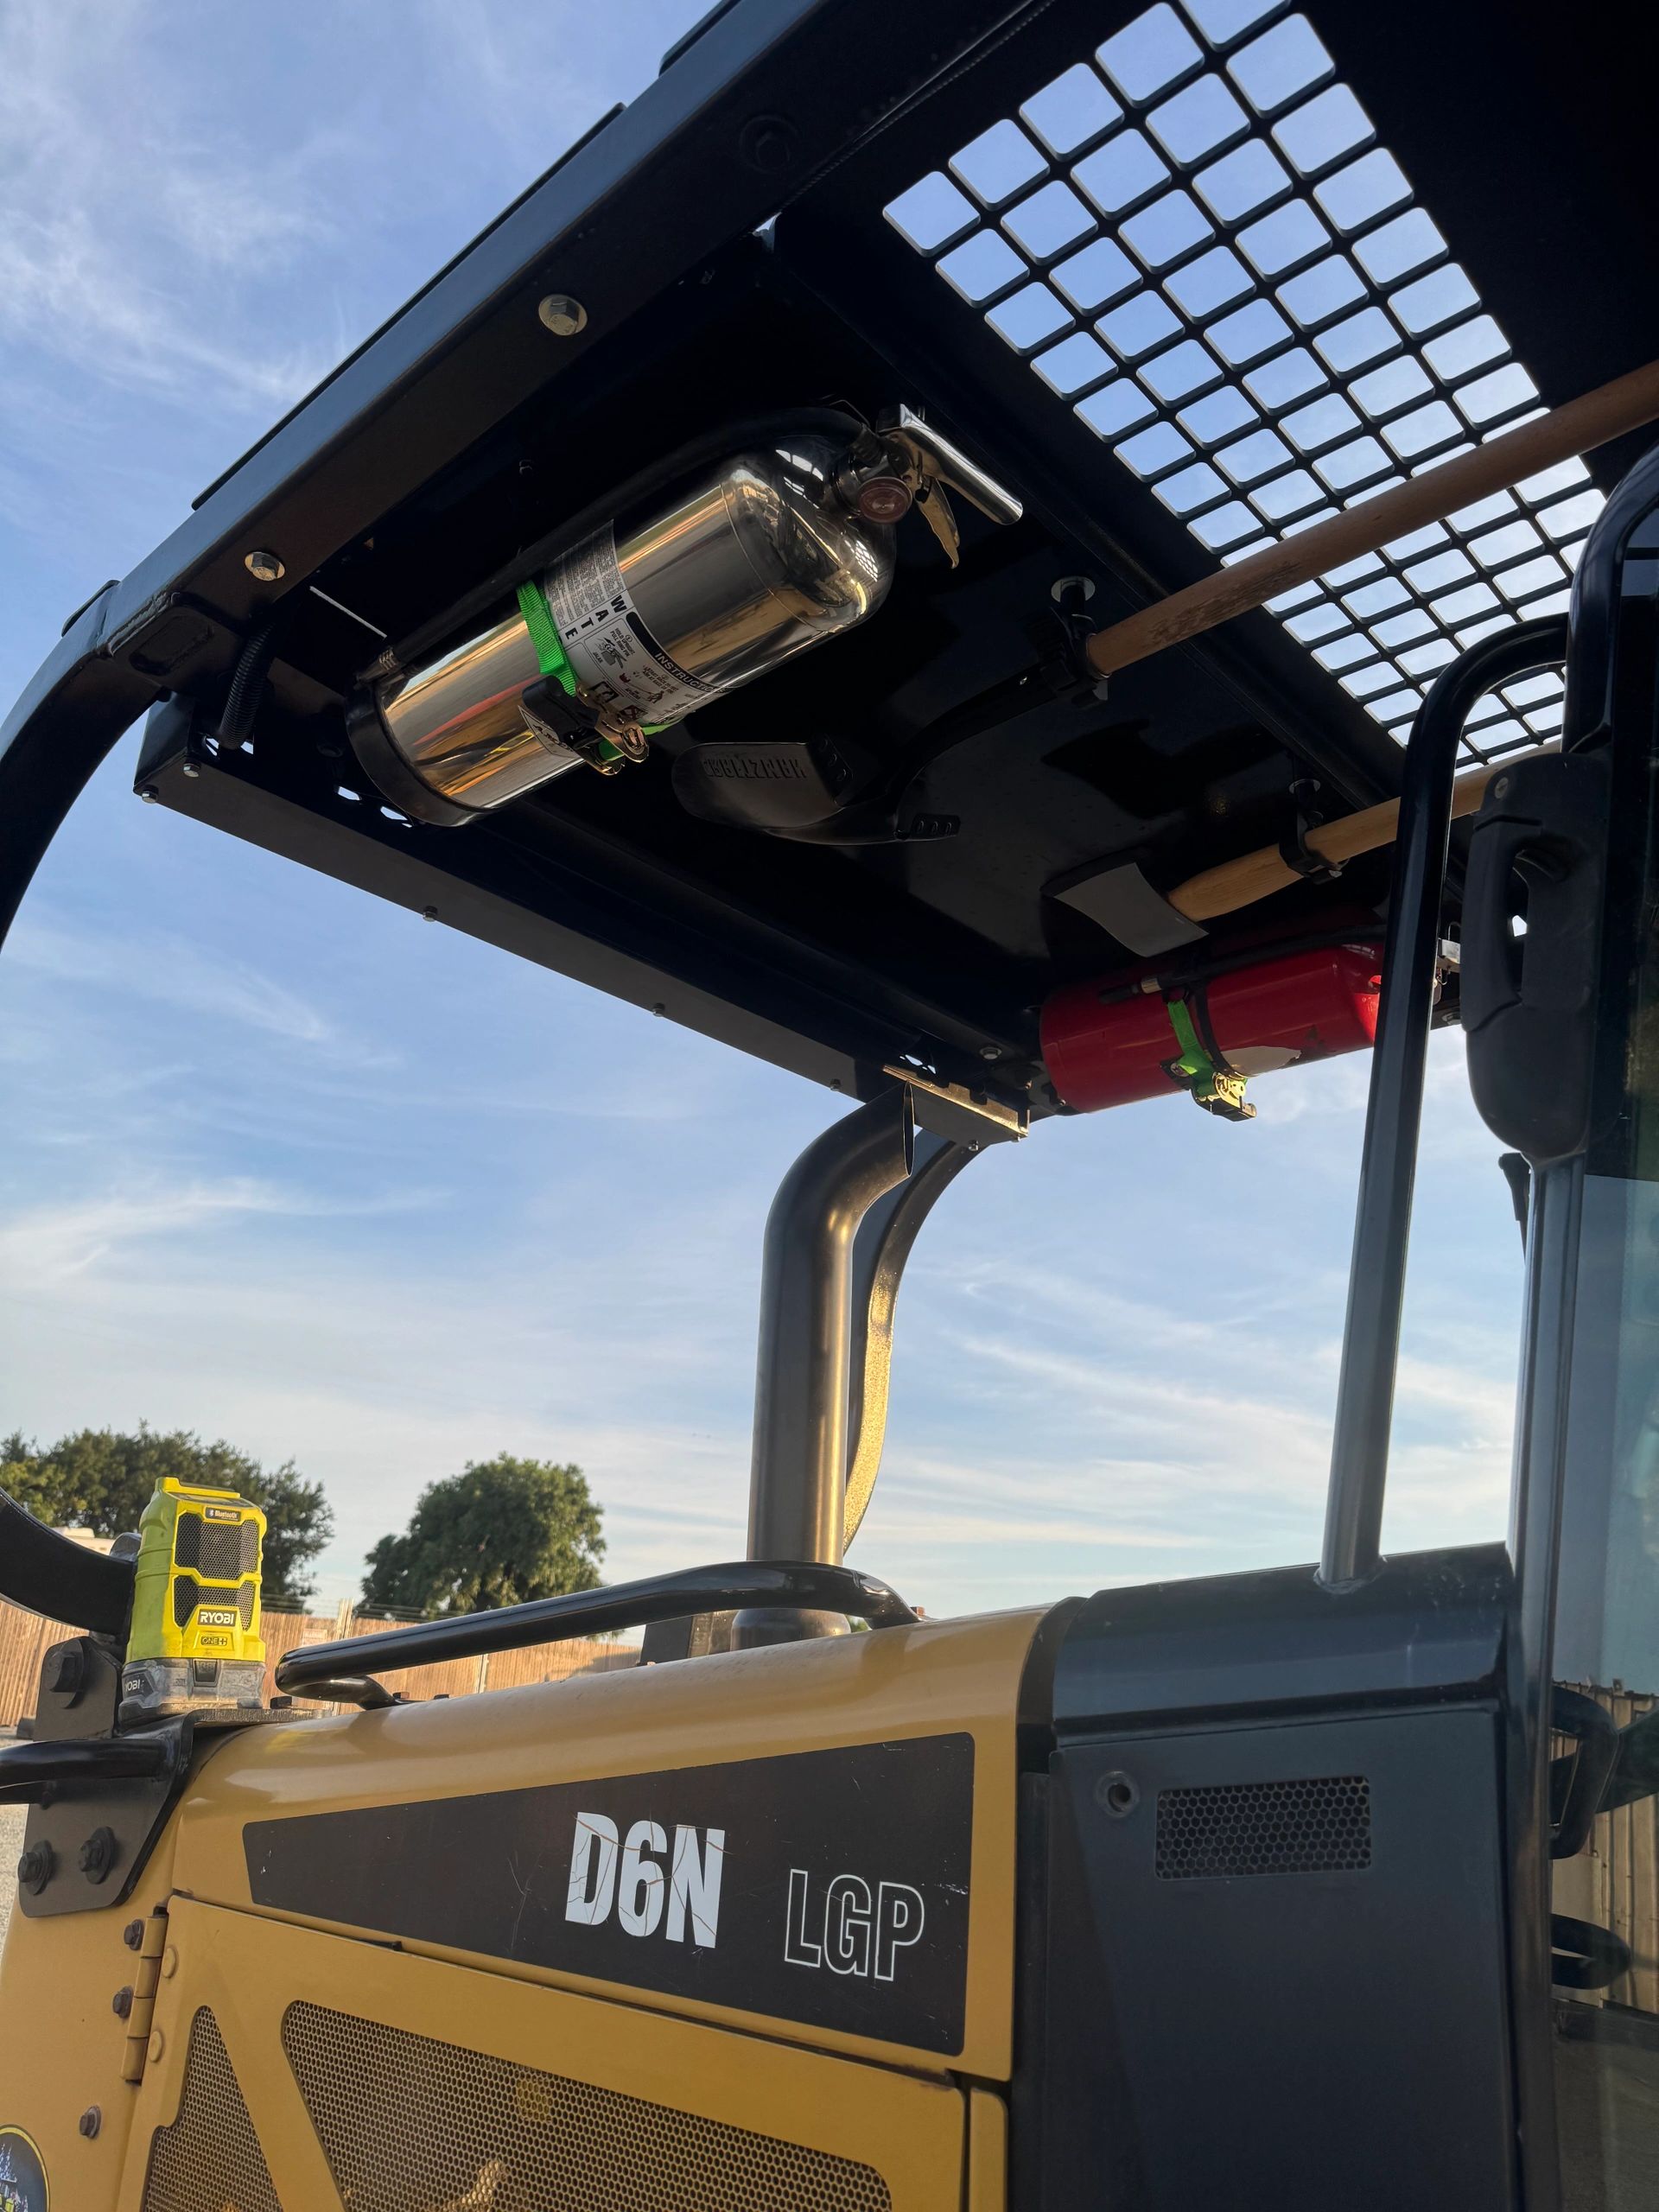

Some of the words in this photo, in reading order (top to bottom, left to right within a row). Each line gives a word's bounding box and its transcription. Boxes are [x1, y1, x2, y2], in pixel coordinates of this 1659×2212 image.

[560, 595, 627, 643] WATE
[654, 652, 728, 693] INSTRUCTIOS
[214, 1510, 238, 1519] Bluetooth
[200, 1611, 235, 1625] RYOBI
[124, 1680, 141, 1691] YOBI
[565, 1812, 726, 1948] D6N
[785, 1868, 925, 1982] LGP
